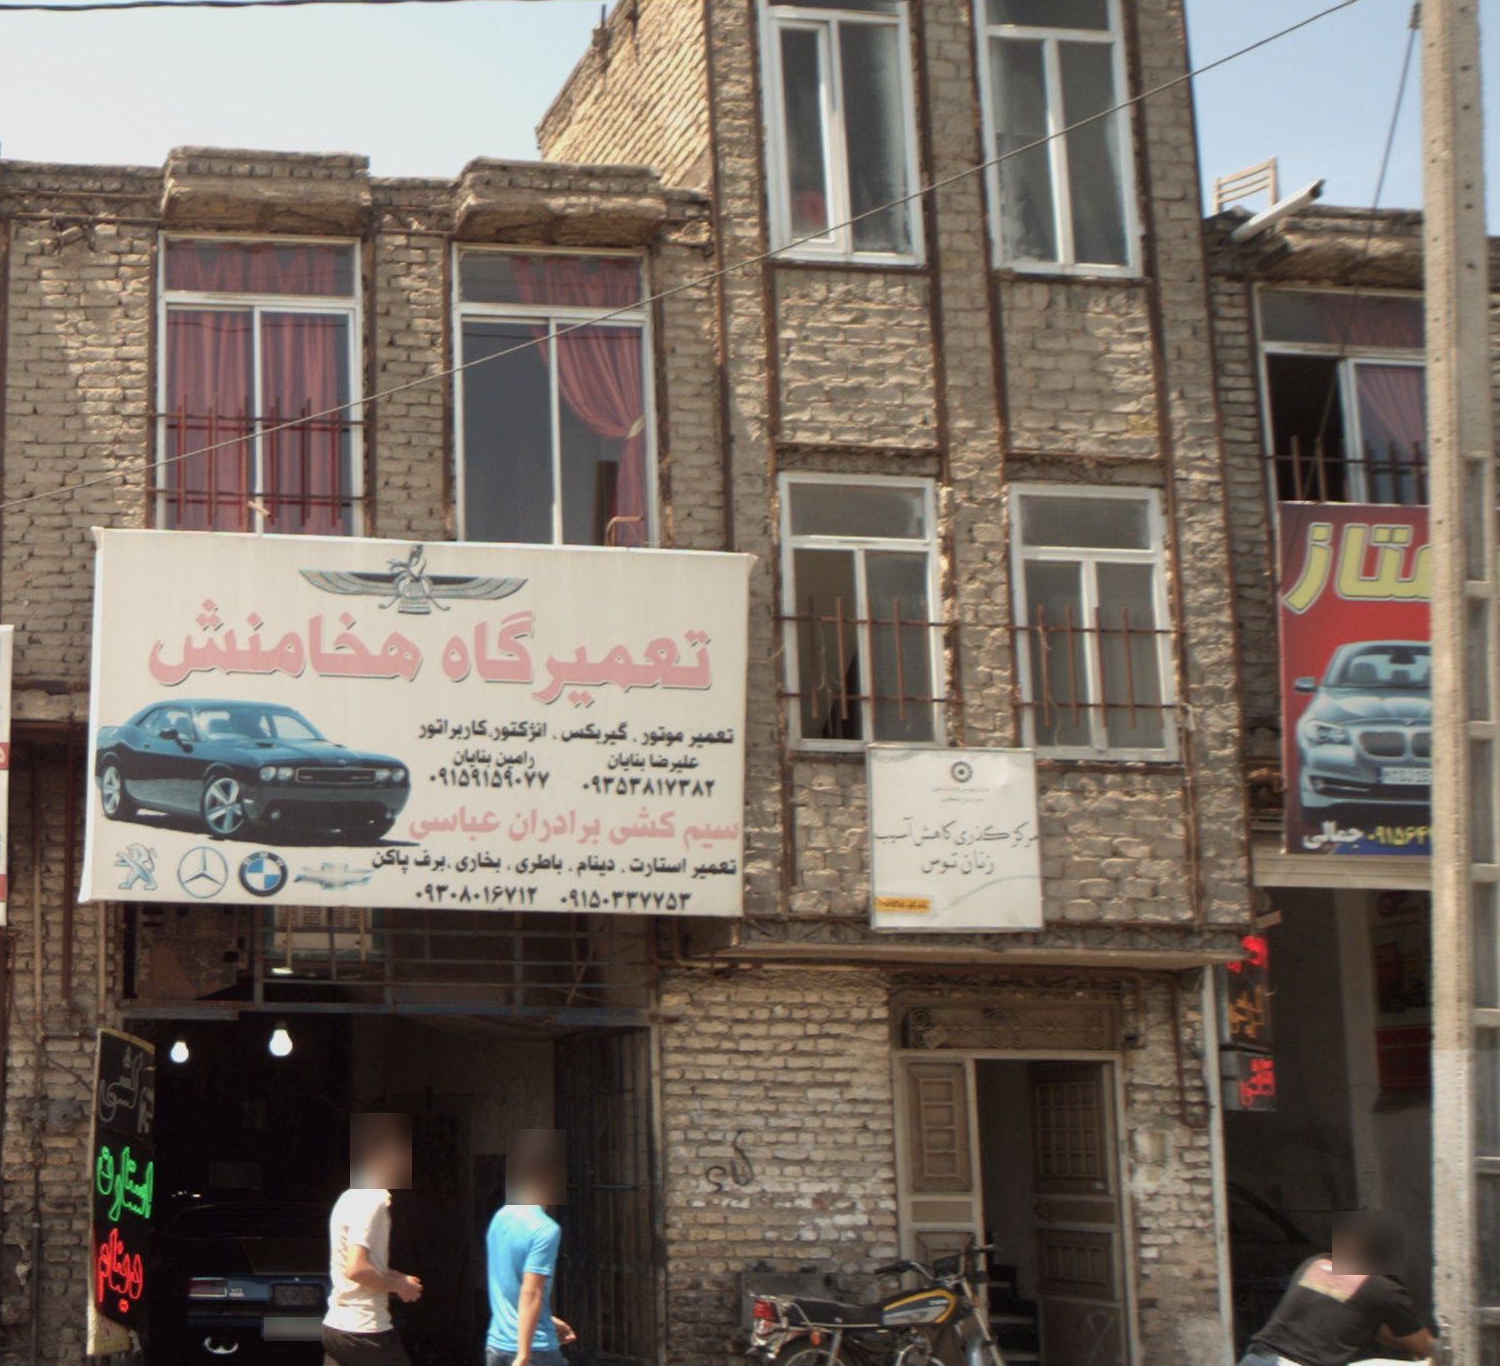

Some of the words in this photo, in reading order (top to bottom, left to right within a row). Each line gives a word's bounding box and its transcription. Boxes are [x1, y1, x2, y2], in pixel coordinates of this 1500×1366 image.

[149, 598, 422, 686] هخامنش
[441, 610, 711, 707] تعمیرگاه
[641, 727, 683, 746] موتور
[688, 729, 734, 747] تعمیر
[496, 751, 535, 768] رامین
[649, 753, 699, 773] علیرضا
[409, 805, 500, 840] عباسی
[509, 809, 600, 844] برادران
[608, 806, 676, 844] کشی
[682, 822, 739, 850] سیم
[1303, 820, 1364, 850] جمالی
[455, 852, 501, 873] بخاری
[515, 855, 563, 874] باطری
[576, 858, 615, 876] دینام
[629, 856, 686, 876] استارت
[691, 859, 737, 879] تعمیر
